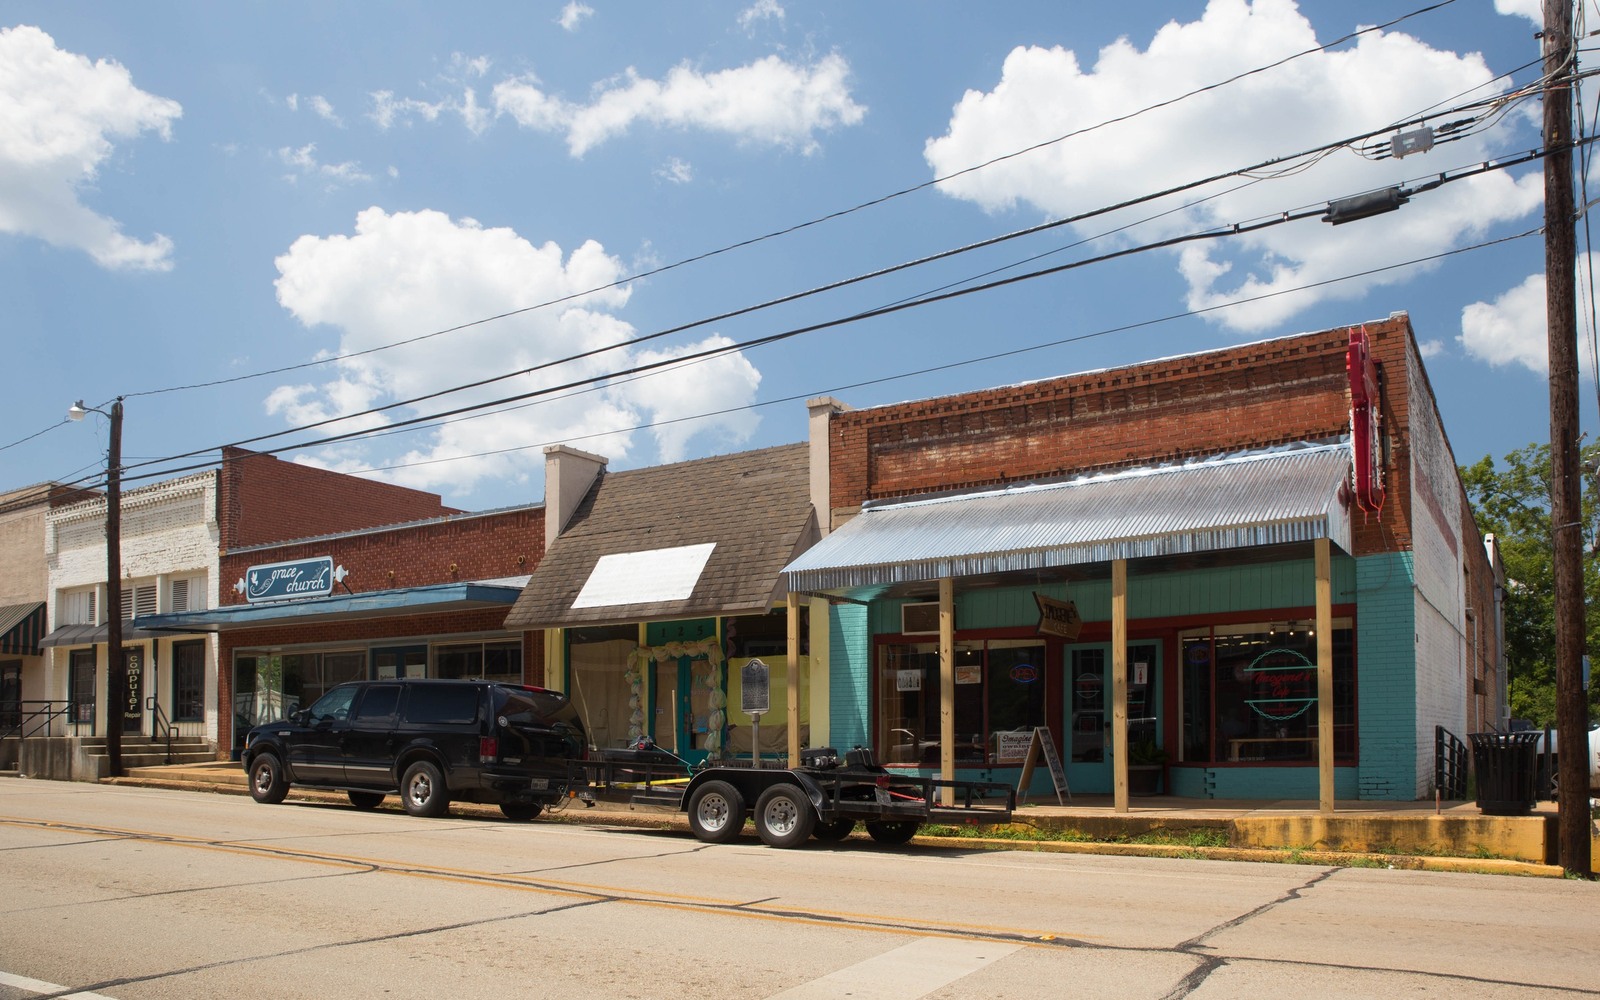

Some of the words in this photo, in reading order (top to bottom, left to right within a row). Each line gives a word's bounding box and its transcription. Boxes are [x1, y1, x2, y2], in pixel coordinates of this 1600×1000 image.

[271, 567, 297, 581] grace
[286, 567, 329, 593] church
[127, 655, 140, 711] computer
[124, 711, 141, 719] Repair
[1002, 734, 1032, 744] Imagine
